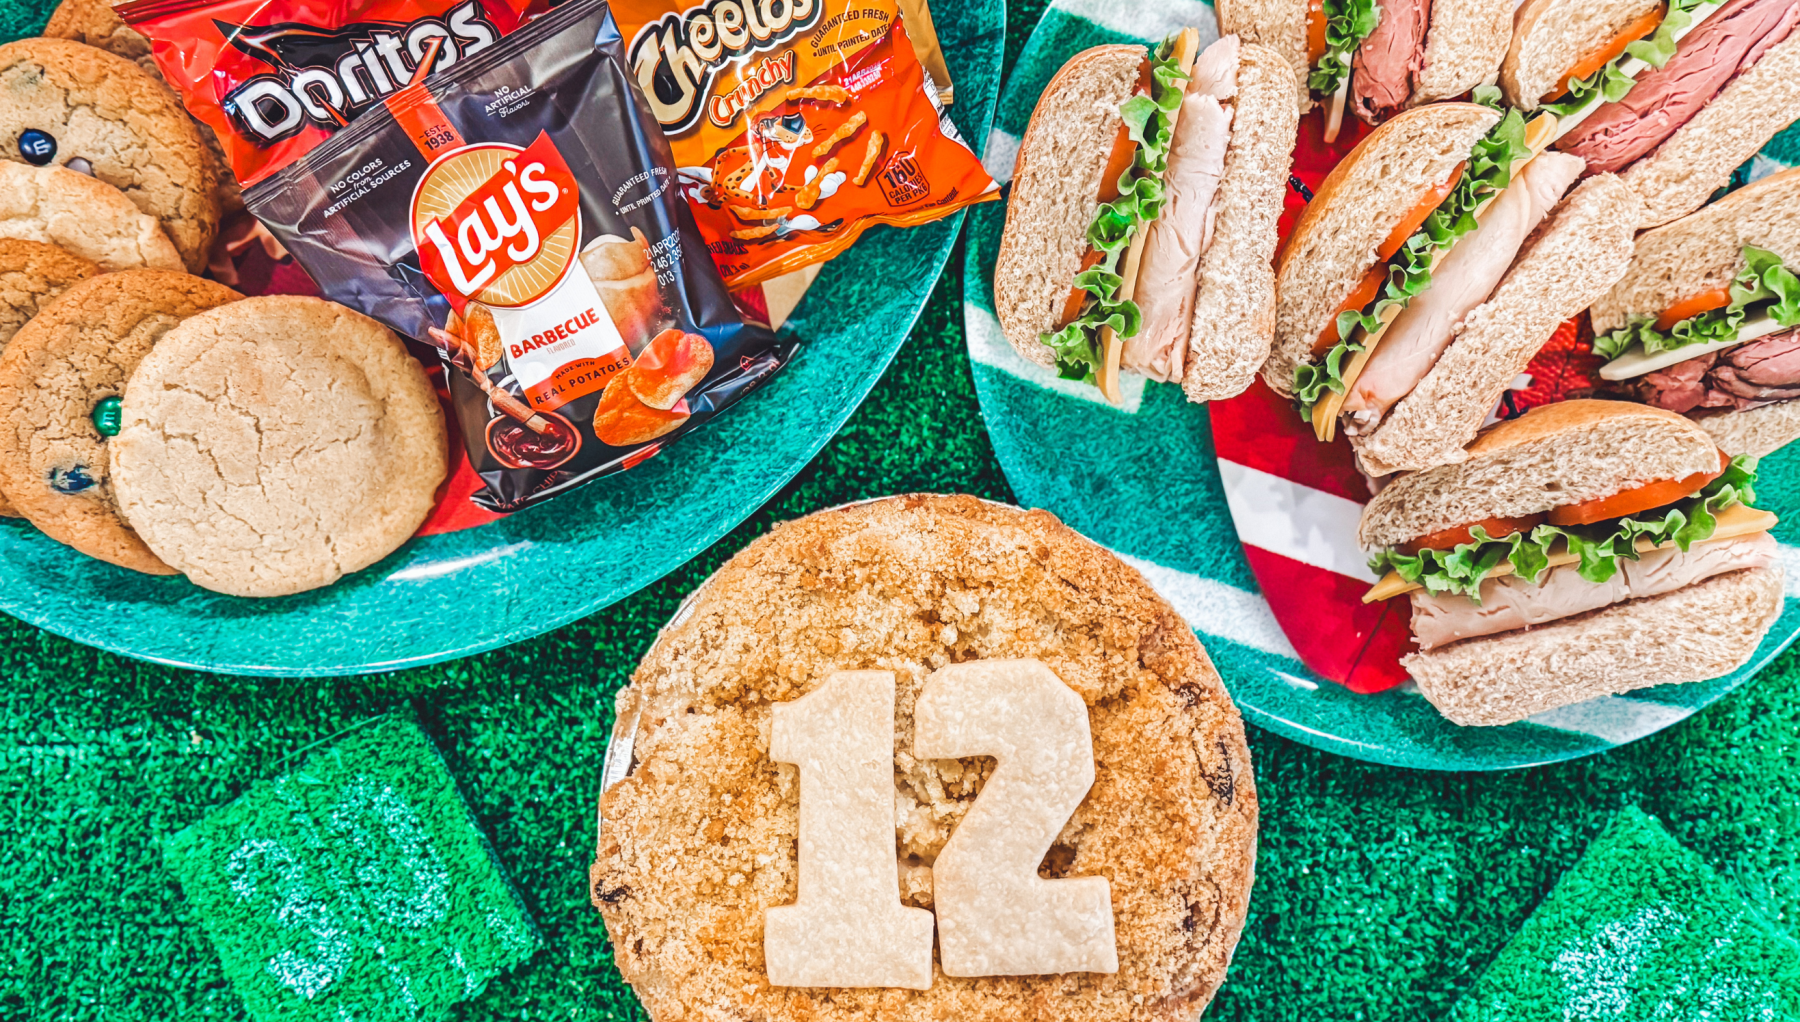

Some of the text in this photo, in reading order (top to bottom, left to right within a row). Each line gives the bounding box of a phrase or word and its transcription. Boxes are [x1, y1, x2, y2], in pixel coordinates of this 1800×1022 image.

[810, 8, 890, 49] GUARANTEED FRESH
[817, 45, 837, 57] UNTIL
[871, 23, 888, 39] DATE
[233, 1, 494, 140] Doritos
[484, 85, 532, 113] ARTIFICIAL
[494, 85, 510, 99] NO
[710, 50, 794, 127] Crunchy
[498, 99, 530, 118] Flavors
[424, 130, 454, 151] 1938
[323, 159, 411, 219] ARTIFICIAL SOURCES
[330, 157, 383, 194] NO COLORS
[353, 176, 373, 190] from
[612, 166, 668, 206] GUARANTEED FRESH
[883, 157, 916, 190] 160
[620, 203, 637, 215] UNTIL
[636, 189, 661, 209] PRINTED
[894, 193, 913, 205] PER
[425, 160, 560, 297] Lay's
[657, 270, 675, 287] 013
[510, 307, 600, 360] BARBECUE
[546, 338, 576, 355] FLAVORED
[534, 357, 631, 405] REAL POTATOES
[555, 360, 596, 380] MADE WITH
[764, 657, 1120, 991] 12
